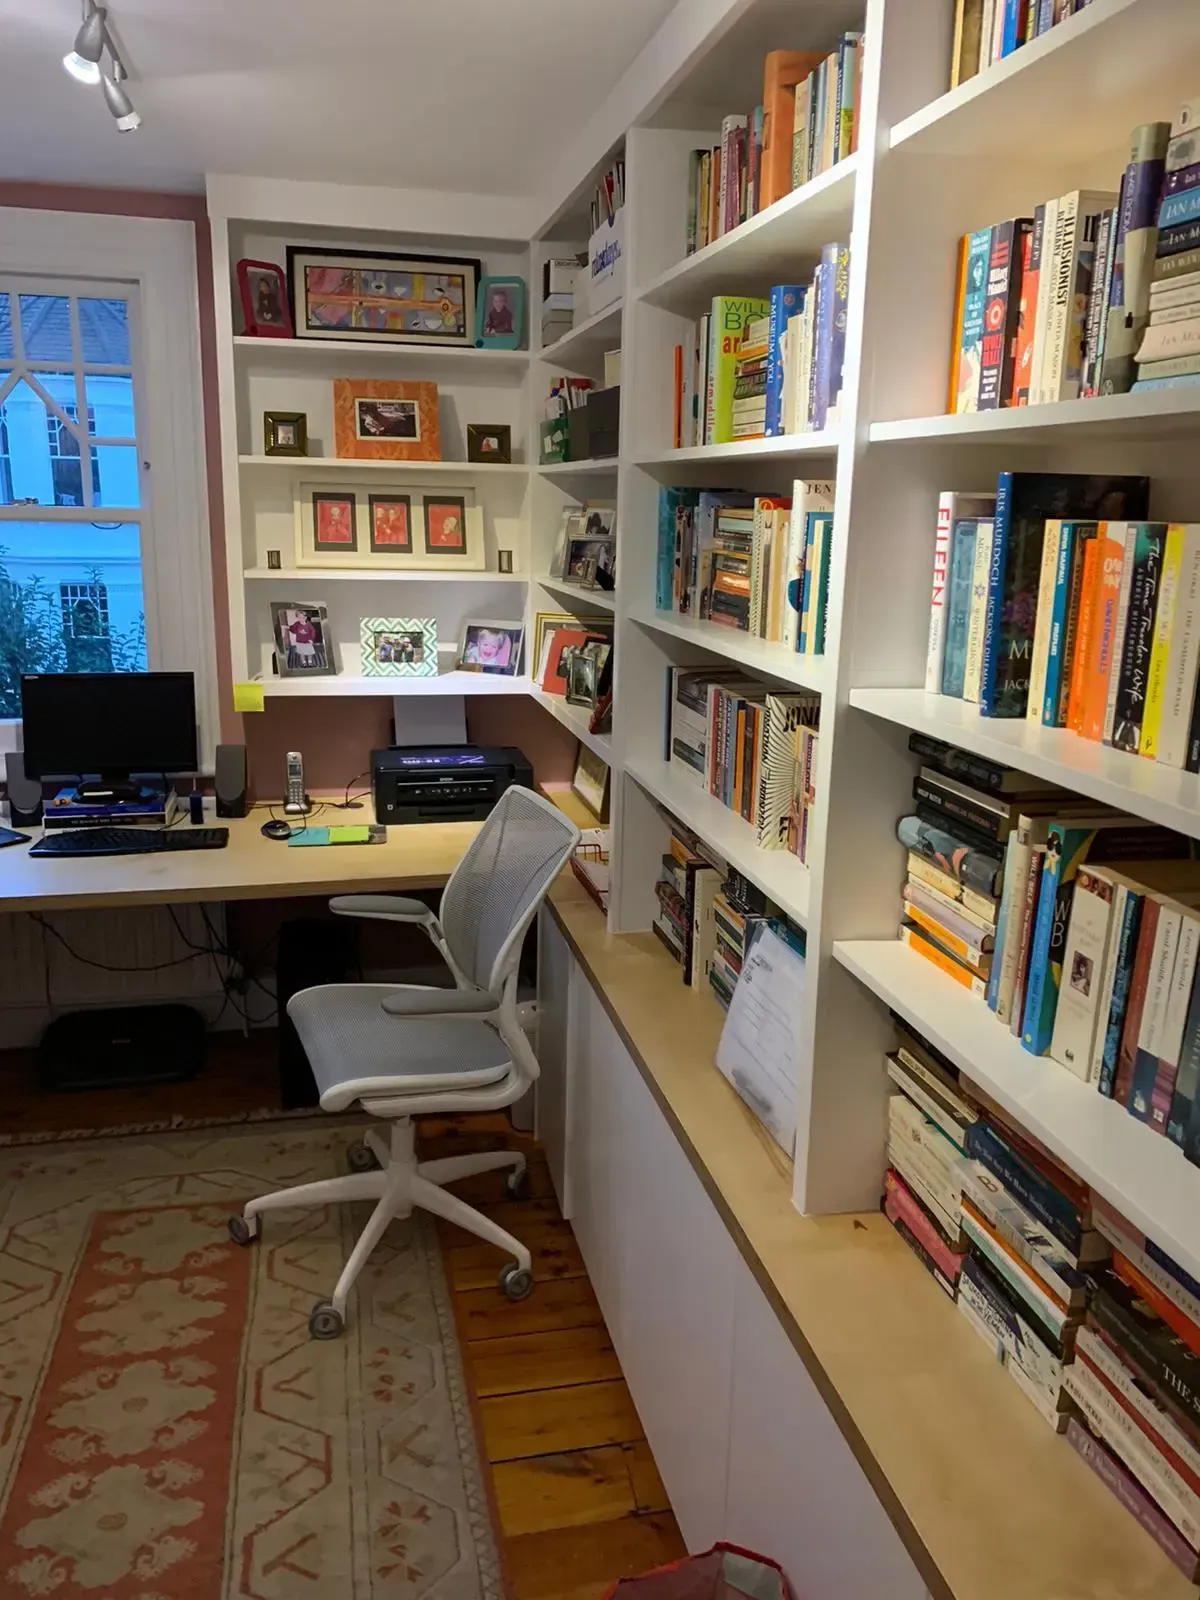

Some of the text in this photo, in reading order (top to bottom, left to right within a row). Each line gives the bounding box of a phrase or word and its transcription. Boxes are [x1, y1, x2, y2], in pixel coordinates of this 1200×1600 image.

[1051, 210, 1064, 257] BETHANY
[1056, 215, 1076, 307] ILLUSIONIST
[725, 300, 770, 314] WILL
[768, 305, 776, 355] MUSEUM
[707, 376, 715, 433] armadillo
[998, 487, 1007, 512] IRIS
[931, 508, 951, 608] EILEEN
[990, 512, 1005, 586] MURDOCH
[1056, 552, 1067, 585] NAIPAUL
[1144, 538, 1163, 571] The
[1133, 568, 1143, 608] AUDREY
[1143, 569, 1155, 608] Time
[1126, 667, 1143, 704] Wife
[757, 707, 772, 832] JONATHAN FRANZEN
[1029, 856, 1038, 878] WILL
[1165, 921, 1173, 947] Carol
[1158, 950, 1169, 983] Shields
[1178, 928, 1193, 990] Carol Shields
[1161, 1363, 1194, 1404] THE
